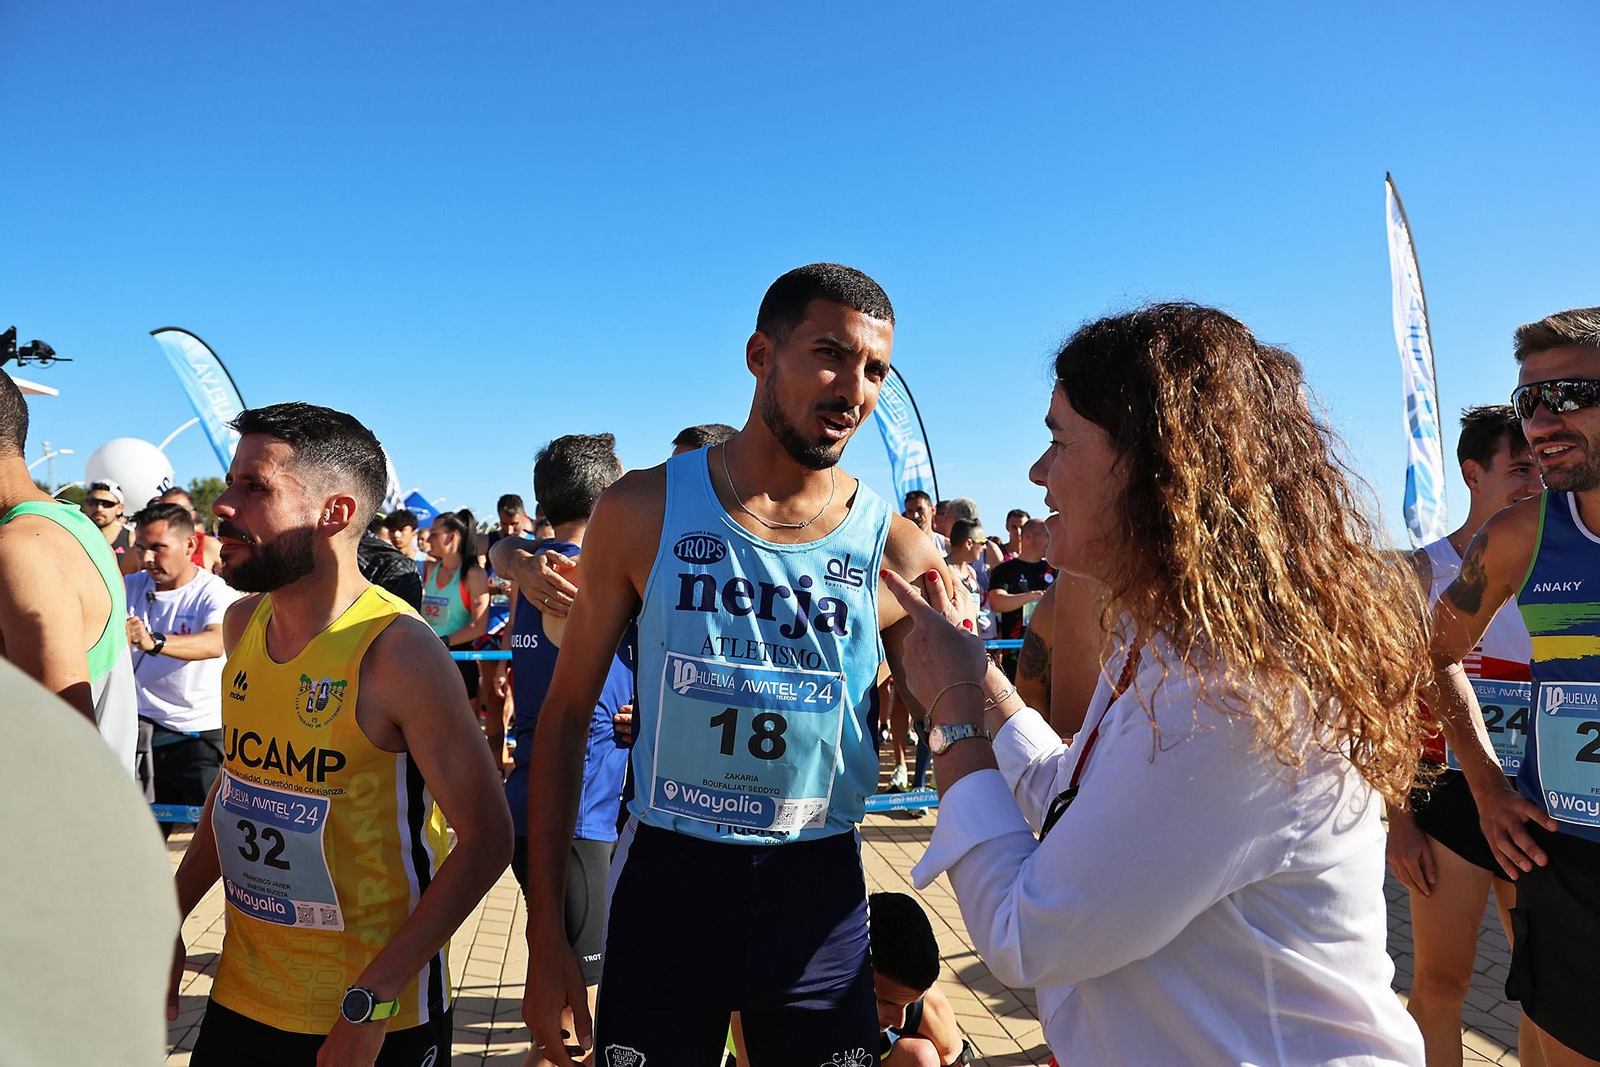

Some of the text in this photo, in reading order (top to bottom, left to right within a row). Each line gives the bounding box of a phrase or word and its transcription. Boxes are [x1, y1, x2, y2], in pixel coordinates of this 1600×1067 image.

[676, 538, 724, 559] TROPS
[1533, 581, 1582, 592] ANAKY
[425, 604, 440, 618] 92
[675, 572, 849, 640] nerja
[700, 634, 822, 670] ATLETISMO
[696, 670, 735, 689] HUELVA
[740, 679, 798, 696] AVATEL
[1474, 685, 1496, 695] UELVA
[1563, 692, 1598, 705] HUELVA
[1481, 705, 1529, 736] 24
[710, 707, 788, 760] 18
[1575, 720, 1600, 764] 2
[1499, 756, 1521, 768] alia
[263, 778, 293, 790] cuestión
[293, 781, 303, 792] de
[724, 772, 759, 782] ZAKARIA
[702, 779, 781, 795] BOUFALJAT SEDDYQ
[230, 787, 250, 805] HUELVA
[252, 796, 290, 816] AVATEL
[681, 785, 763, 815] Wayalia
[237, 820, 291, 871] 32
[243, 872, 291, 890] FRANCISCO JAVIER
[246, 882, 289, 898] MARTIN BUCETA
[234, 884, 286, 915] Wayalia
[583, 953, 602, 962] TROT
